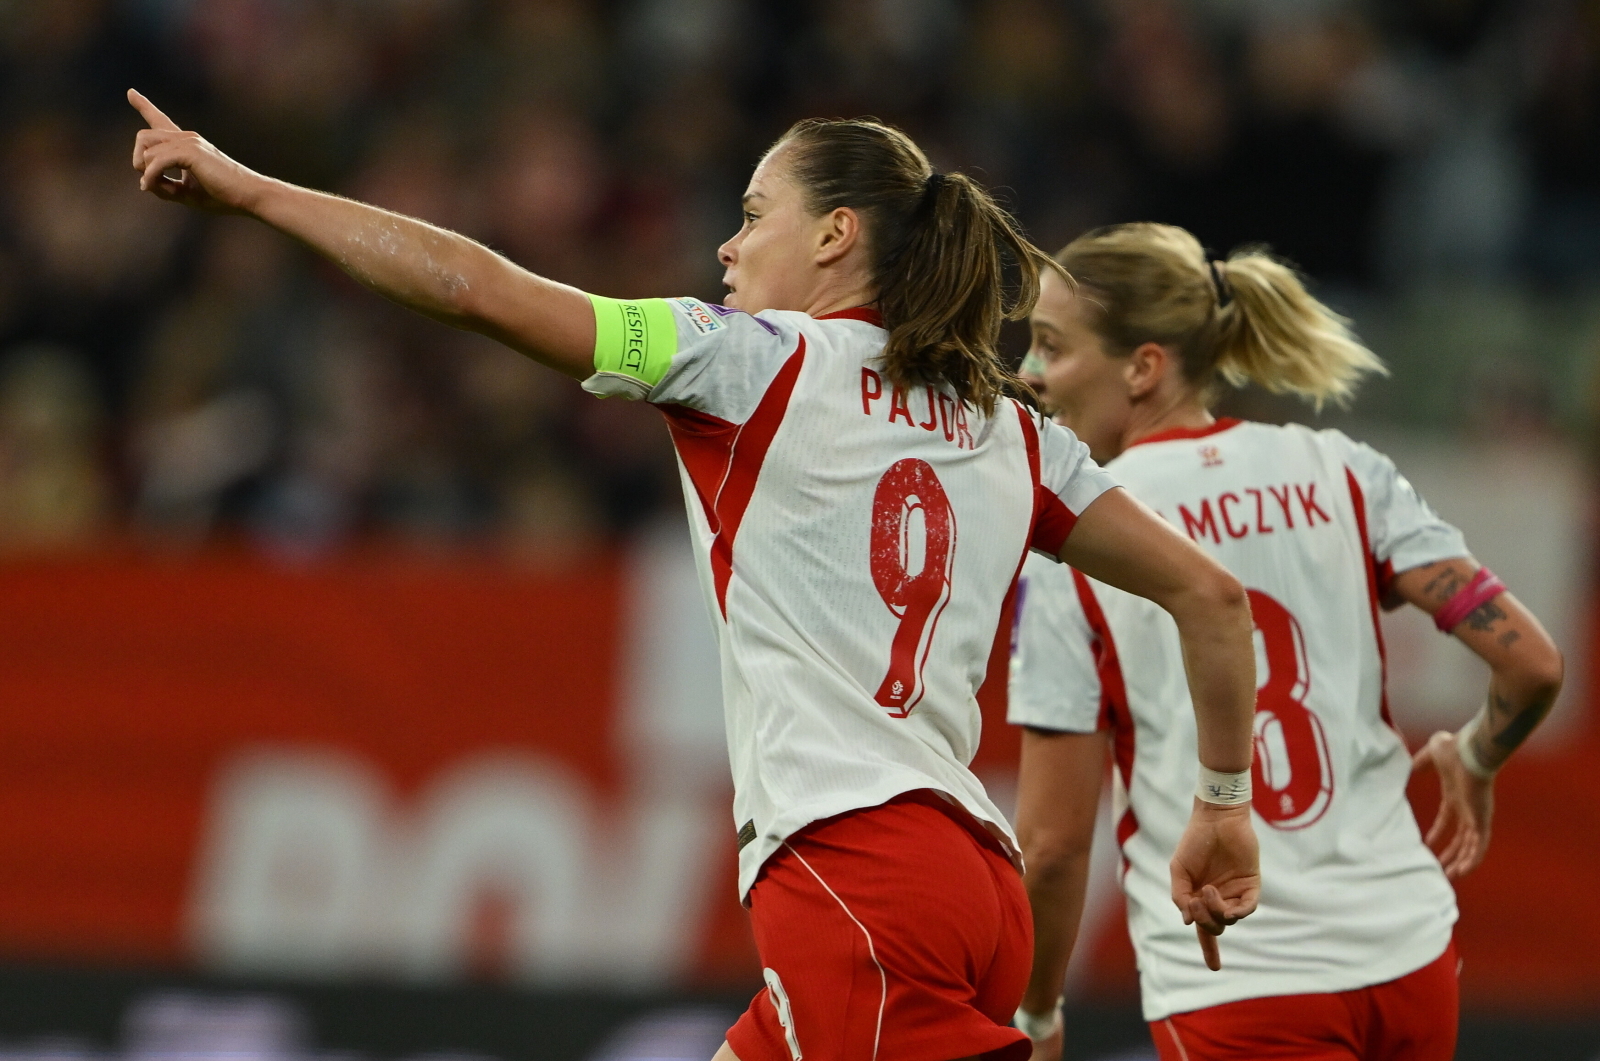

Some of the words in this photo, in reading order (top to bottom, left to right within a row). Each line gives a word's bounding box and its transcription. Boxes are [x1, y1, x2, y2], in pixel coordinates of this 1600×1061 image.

[623, 304, 643, 373] RESPECT
[861, 367, 973, 451] PAJOR
[1155, 481, 1332, 545] MCZYK
[870, 457, 958, 719] 9
